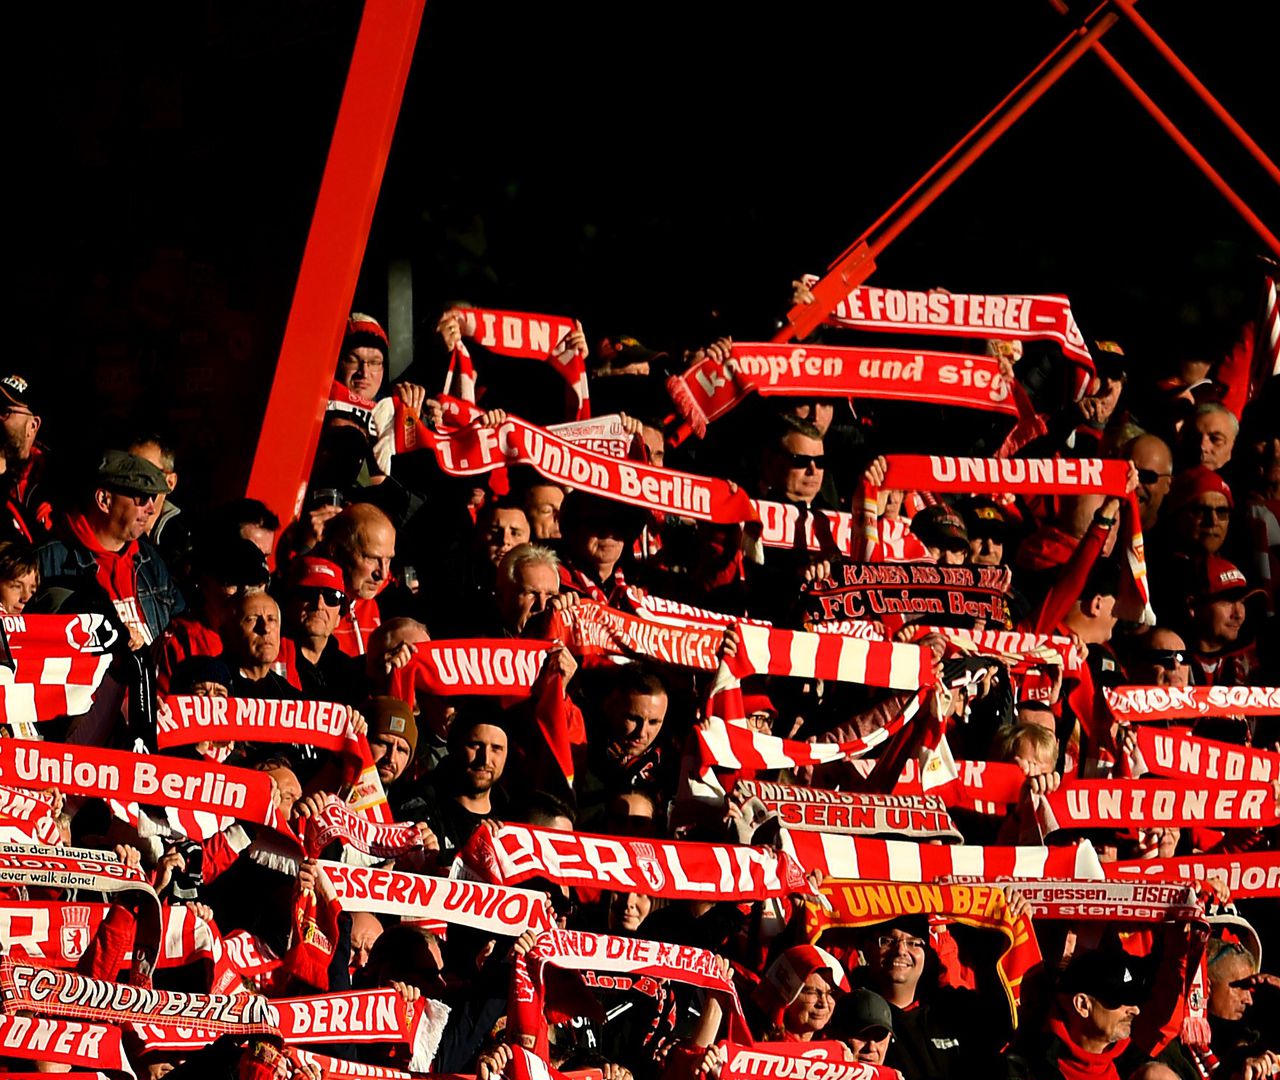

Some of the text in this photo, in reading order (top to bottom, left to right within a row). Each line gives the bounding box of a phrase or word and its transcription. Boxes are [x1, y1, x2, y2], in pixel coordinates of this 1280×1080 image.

[858, 352, 922, 382] und
[439, 430, 475, 470] 1.
[479, 424, 519, 458] FC
[522, 431, 610, 489] Union
[619, 462, 711, 514] Berlin
[930, 455, 1104, 488] UNIONER
[822, 592, 942, 619] FC Union
[14, 749, 121, 789] Union
[132, 763, 247, 808] Berlin
[1068, 789, 1268, 820] UNIONER
[3, 844, 25, 853] aus
[29, 845, 51, 854] der
[502, 825, 782, 899] BERLIN
[30, 871, 54, 882] walk
[57, 874, 95, 887] alone!
[320, 865, 546, 928] EISERN UNION
[851, 886, 944, 916] UNION
[544, 929, 650, 962] SIND DIE
[56, 978, 275, 1025] UNION BERLIN
[294, 996, 398, 1035] BERLIN
